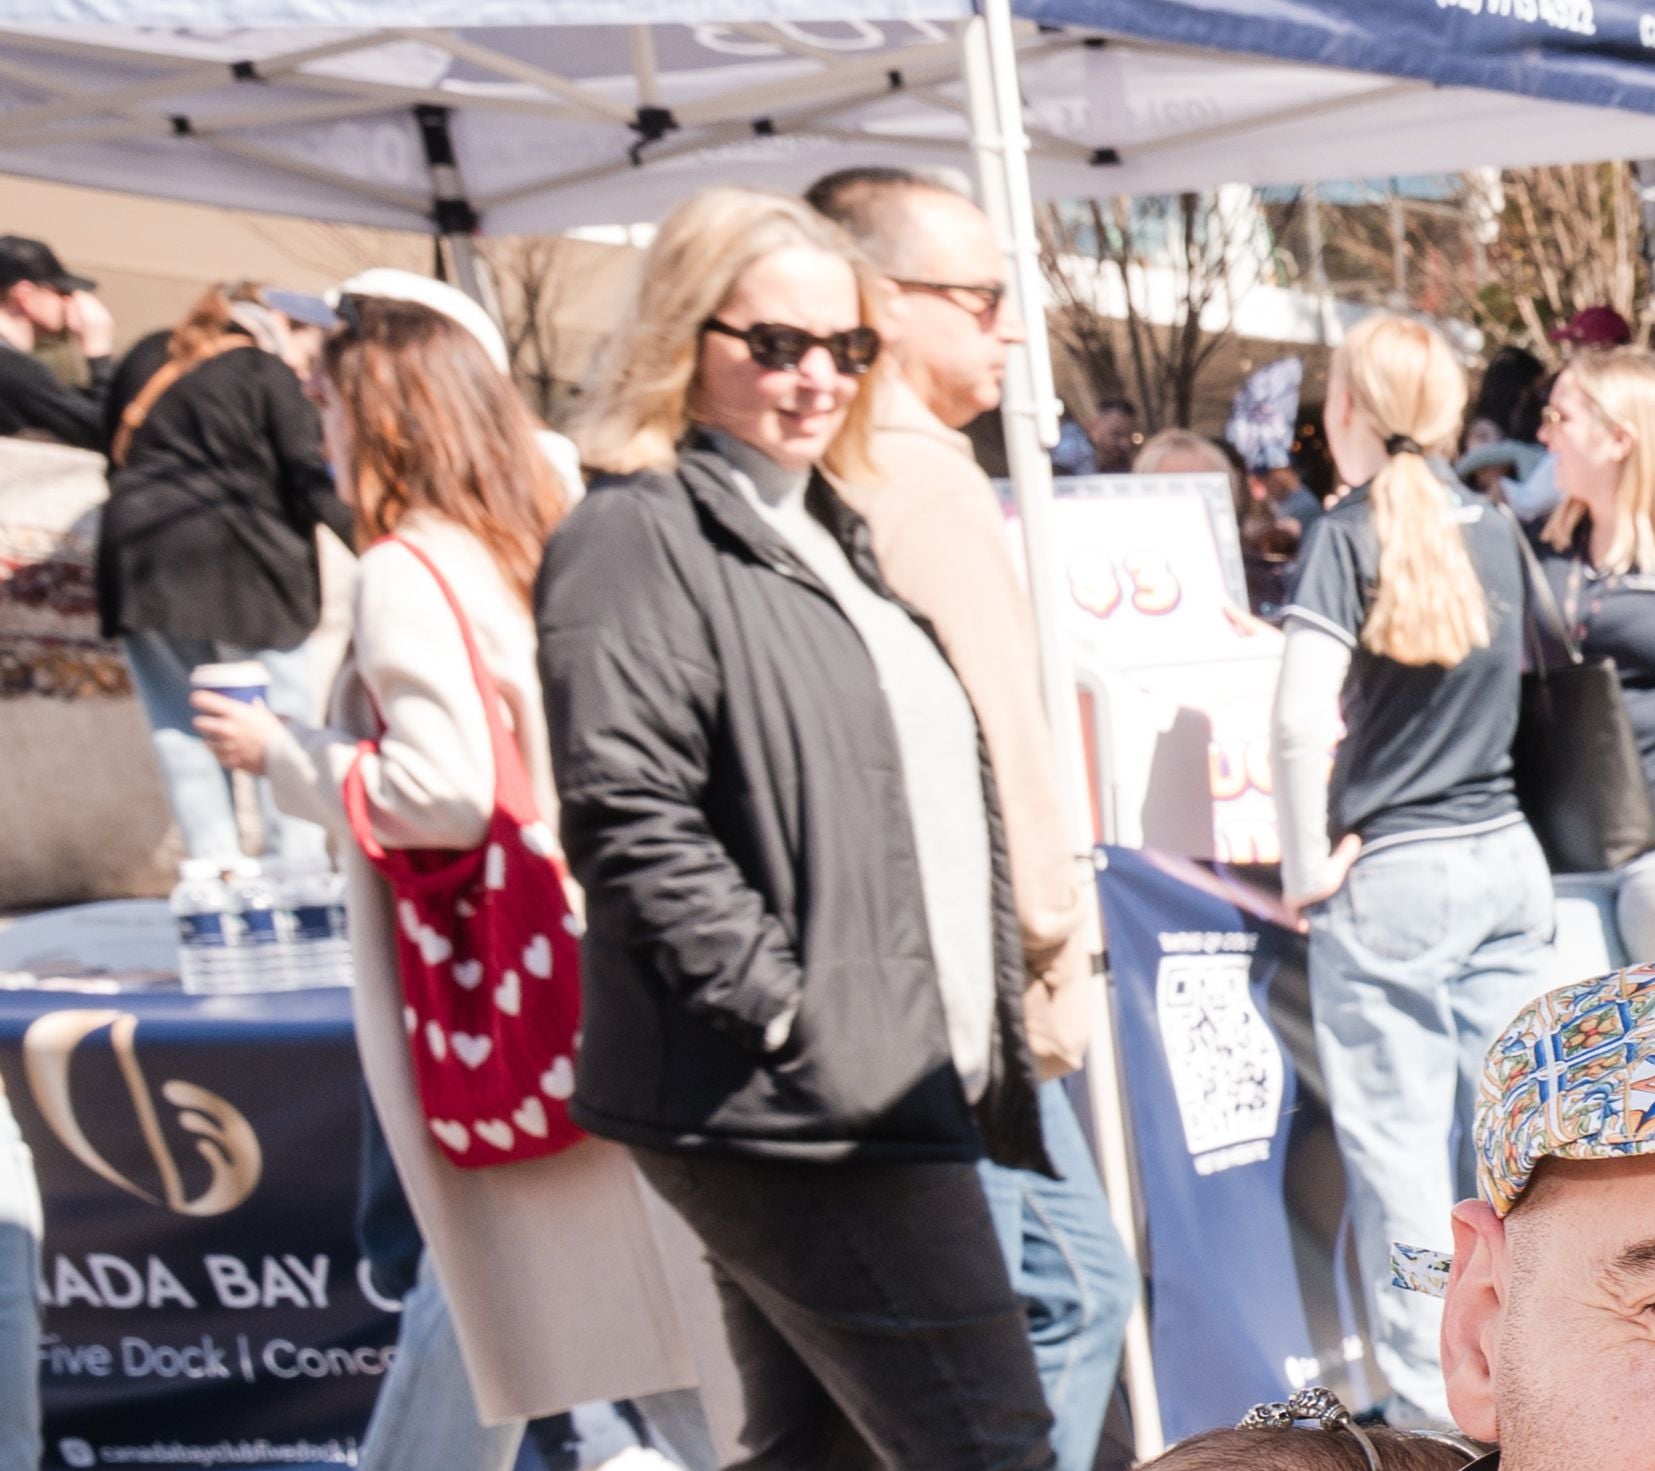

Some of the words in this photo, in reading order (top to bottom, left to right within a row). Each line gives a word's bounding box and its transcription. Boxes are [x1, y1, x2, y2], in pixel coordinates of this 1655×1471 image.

[39, 1253, 197, 1310] ADA
[204, 1253, 331, 1310] BAY
[121, 1334, 231, 1378] Dock
